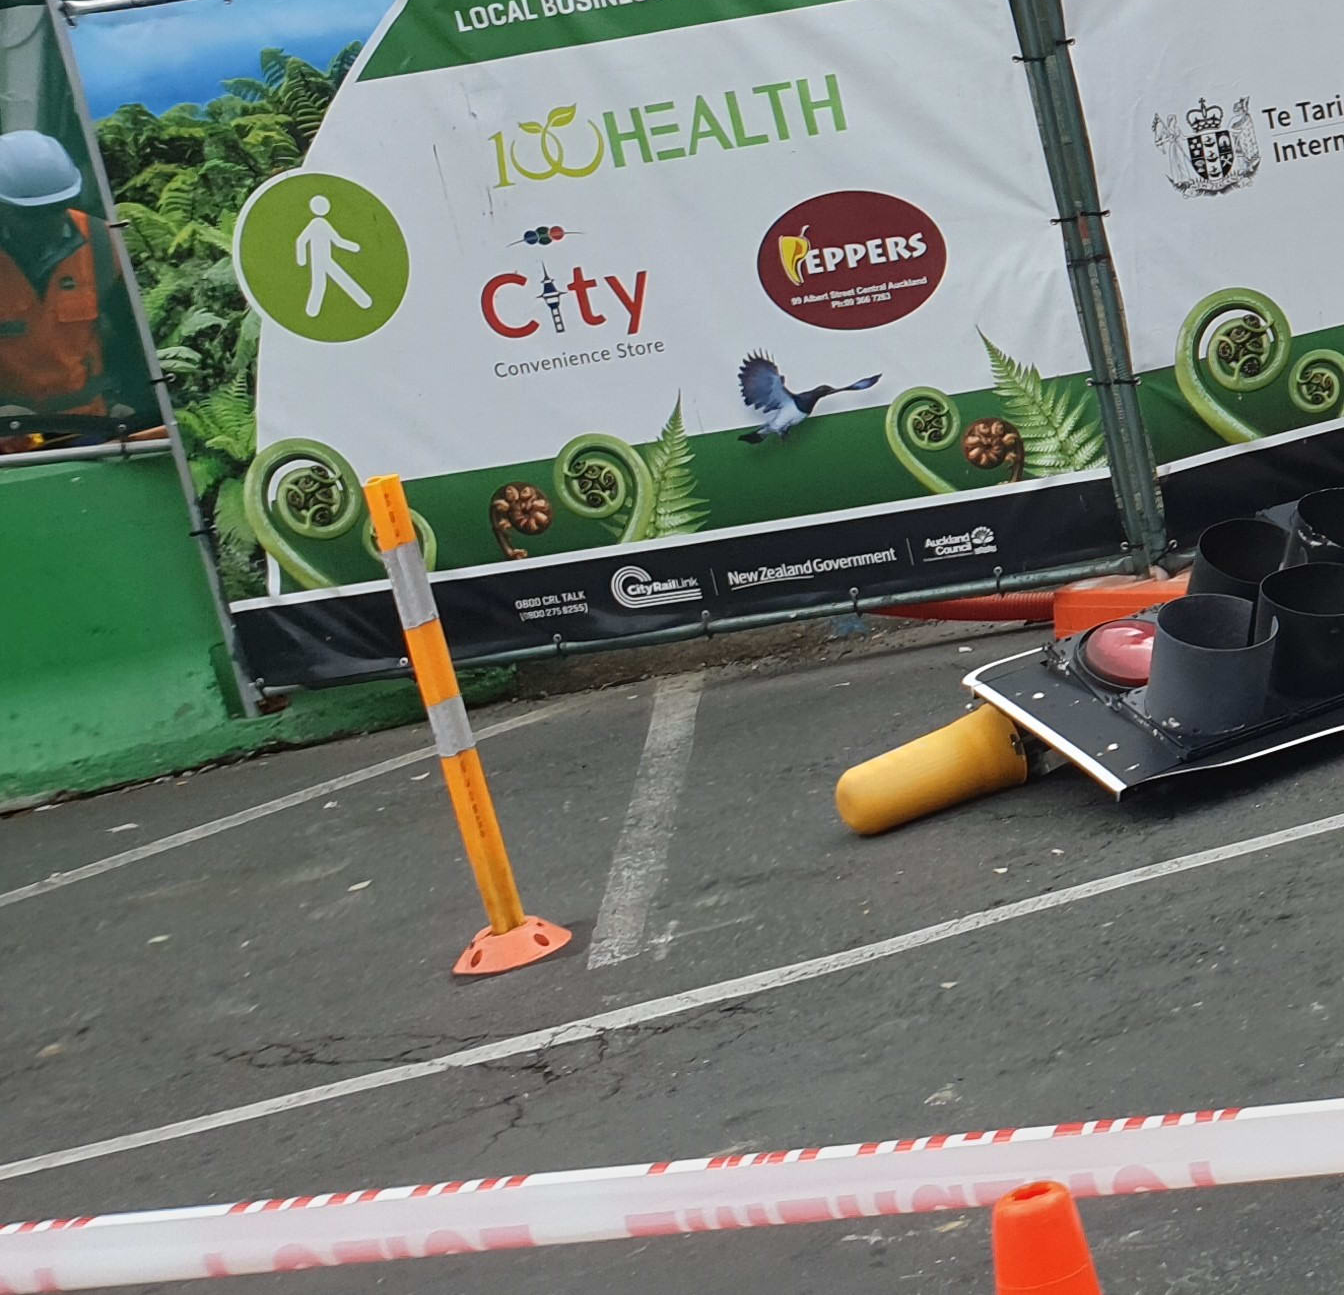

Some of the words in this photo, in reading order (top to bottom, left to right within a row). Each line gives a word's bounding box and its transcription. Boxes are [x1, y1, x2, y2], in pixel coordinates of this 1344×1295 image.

[1262, 105, 1290, 131] Te
[1295, 95, 1344, 127] Tari
[779, 228, 928, 286] PEPPERS
[887, 276, 929, 291] Auckland
[480, 261, 648, 340] City
[494, 348, 612, 379] Convenience
[616, 338, 665, 363] Store
[925, 532, 970, 549] Auckland
[935, 542, 973, 556] Council
[727, 569, 759, 587] New
[759, 559, 814, 581] Zealand
[813, 547, 898, 574] Government
[515, 597, 542, 610] 0800
[542, 595, 562, 606] CRL
[561, 590, 586, 603] TALK
[546, 606, 562, 617] 275
